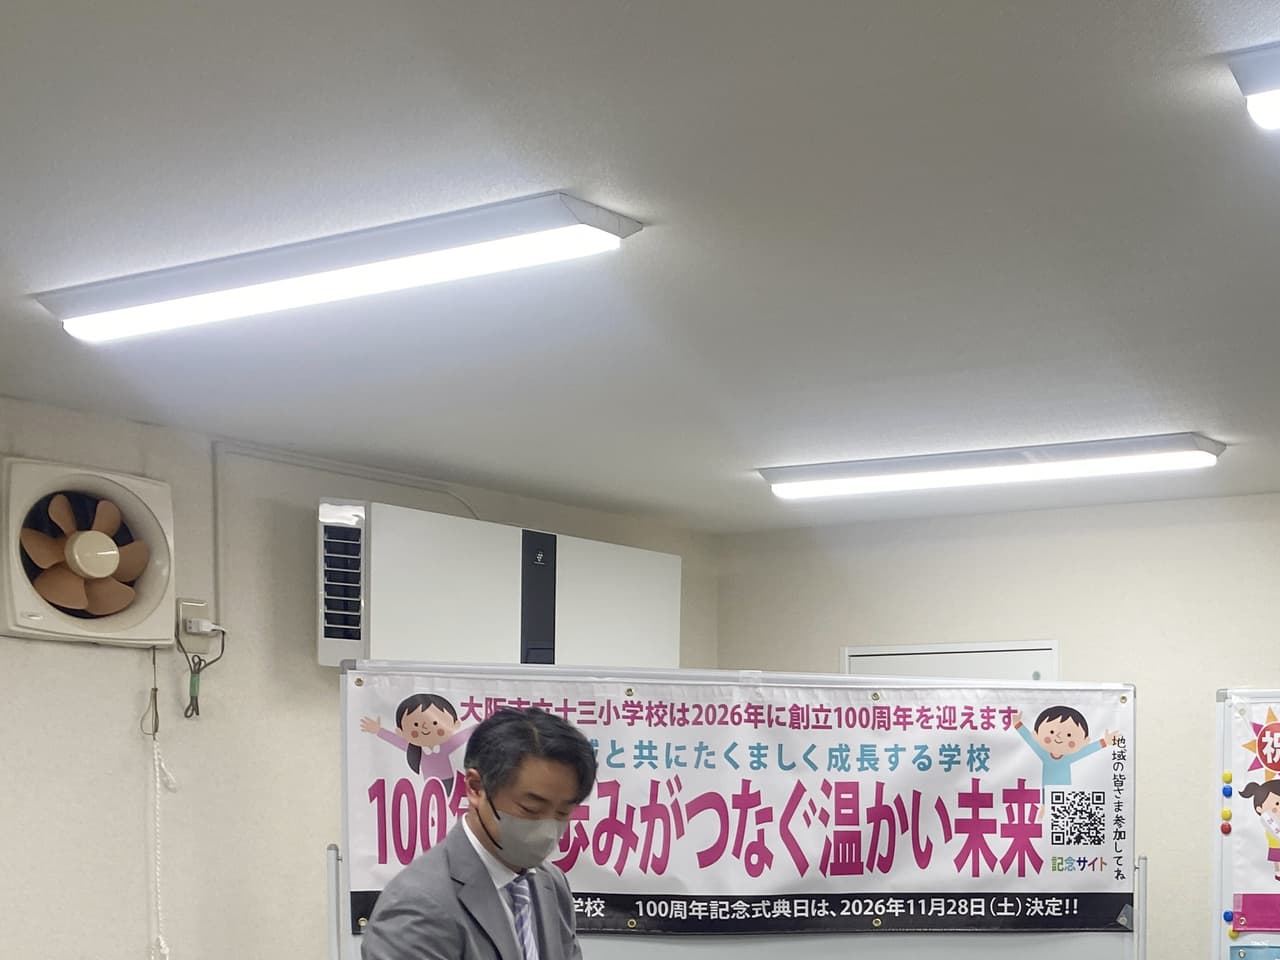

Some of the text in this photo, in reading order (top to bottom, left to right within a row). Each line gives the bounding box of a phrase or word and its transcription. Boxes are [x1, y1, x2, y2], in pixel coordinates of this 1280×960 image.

[1112, 735, 1127, 881] 地域の皆さま参加してね
[1051, 855, 1107, 873] 記念サイト
